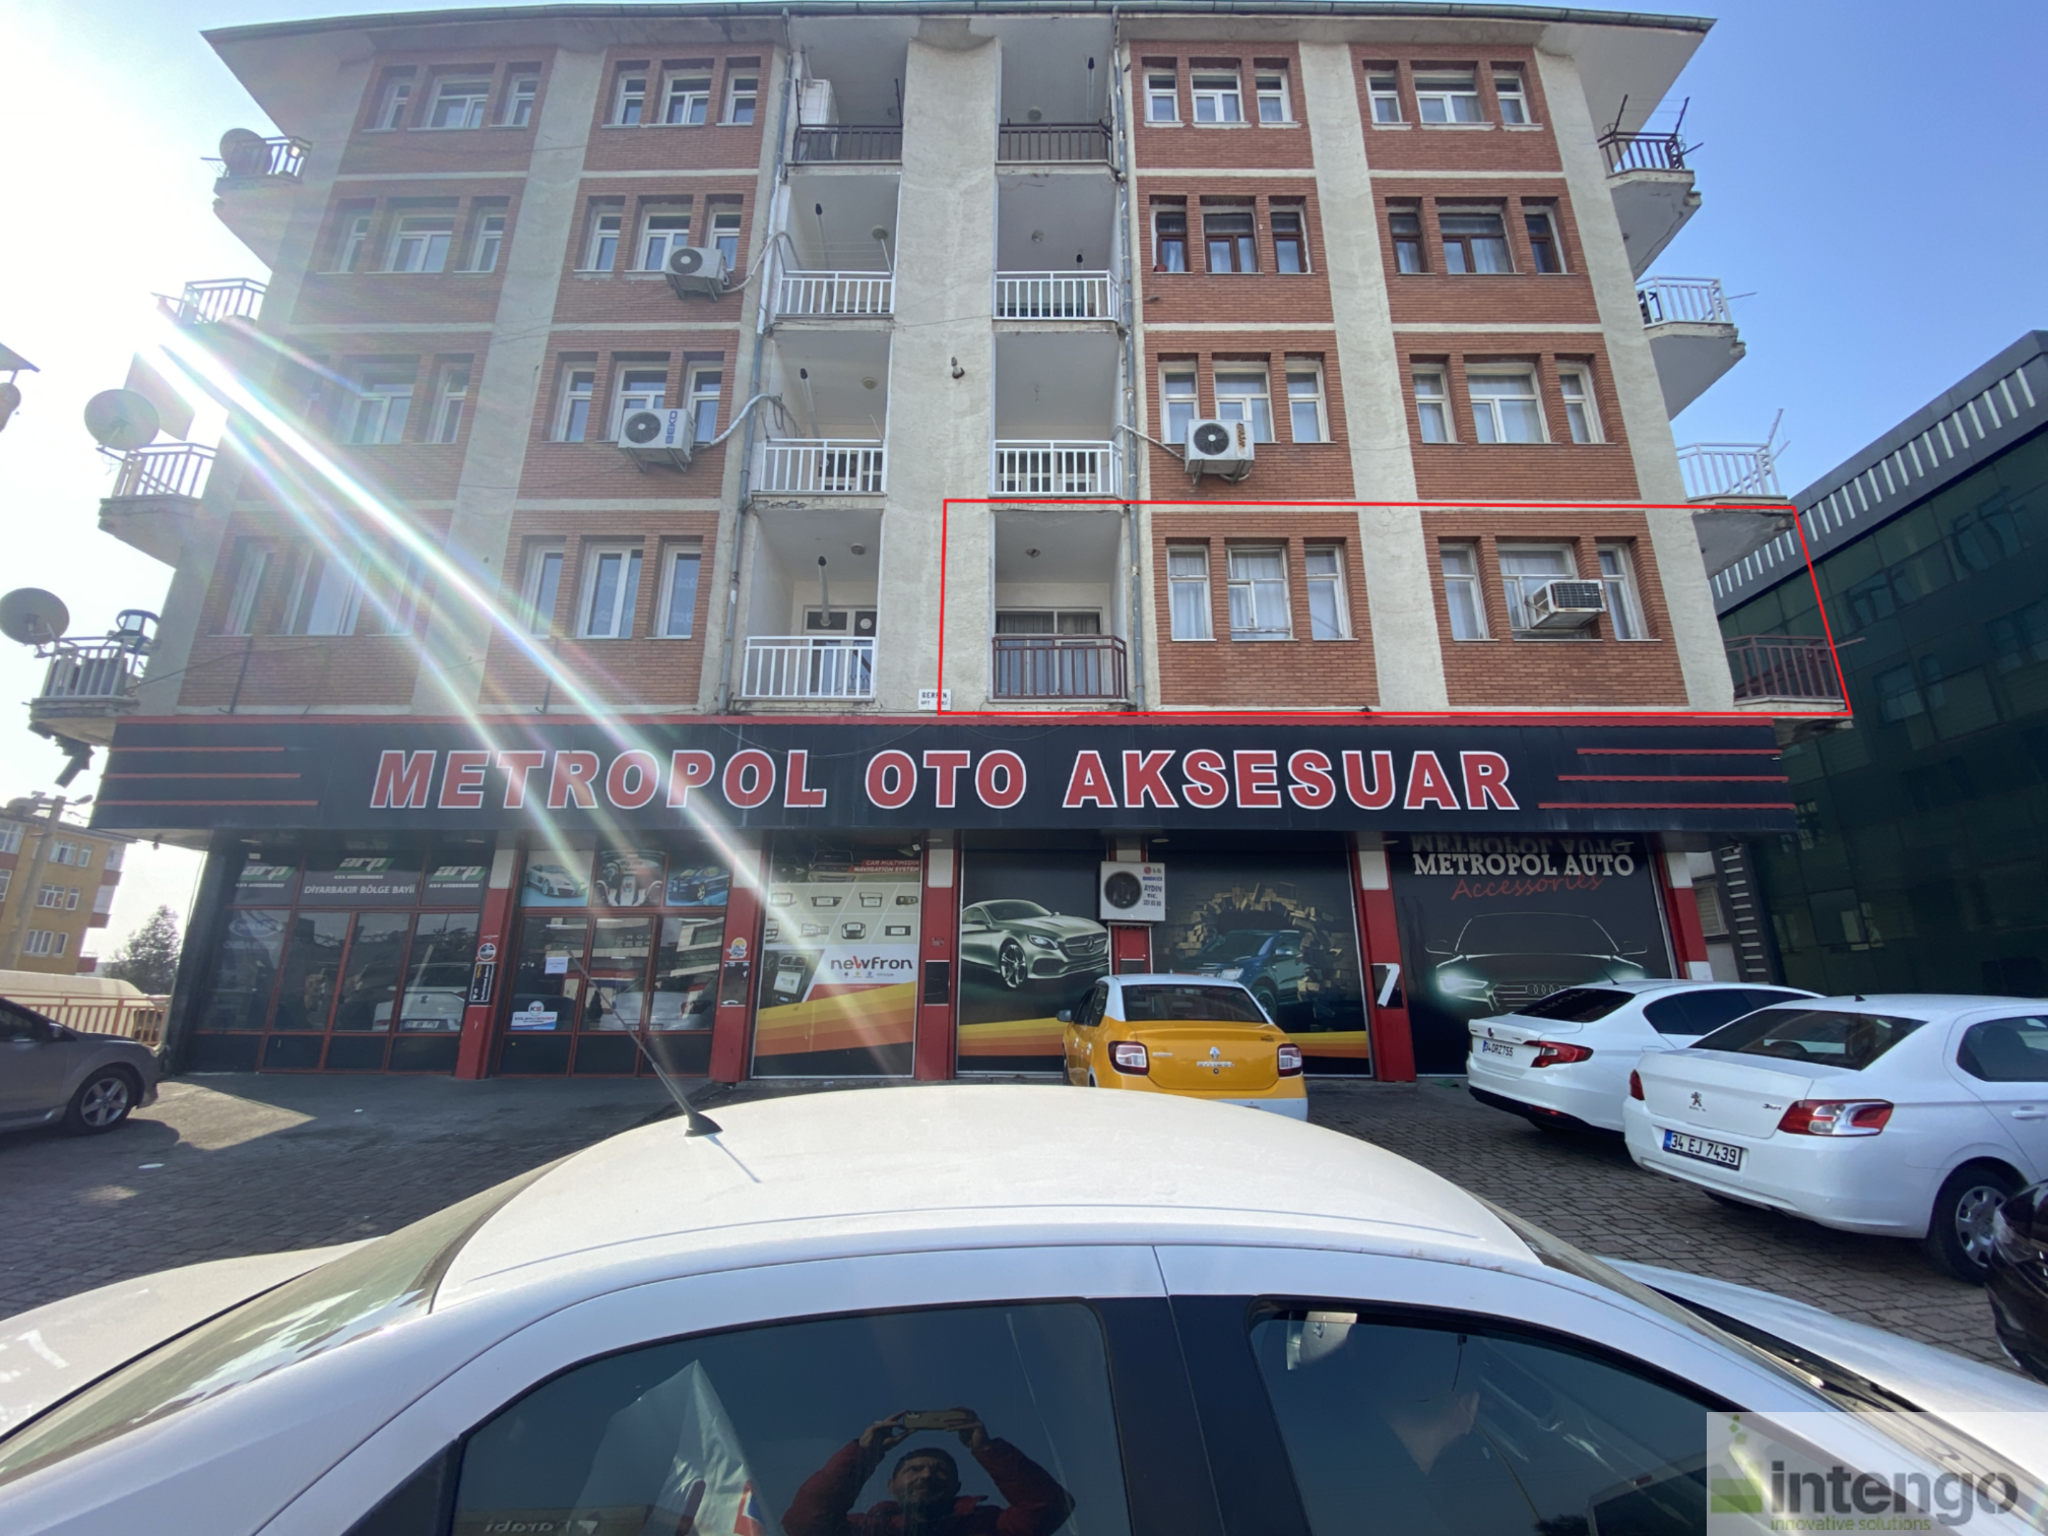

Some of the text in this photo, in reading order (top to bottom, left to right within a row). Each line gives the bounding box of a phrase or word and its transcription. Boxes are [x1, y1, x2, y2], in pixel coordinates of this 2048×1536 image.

[665, 410, 678, 445] BEKO
[370, 749, 1521, 810] METROPOL OTO AKSESUAR
[1412, 853, 1635, 877] METROPOL AUTO
[304, 884, 358, 894] DİYARBAKIR
[359, 884, 391, 894] BÖLGE
[1143, 884, 1163, 893] AYDIN
[1450, 873, 1604, 901] Accessories
[830, 955, 913, 970] newfron
[1671, 1134, 1737, 1163] 34 EJ 7439
